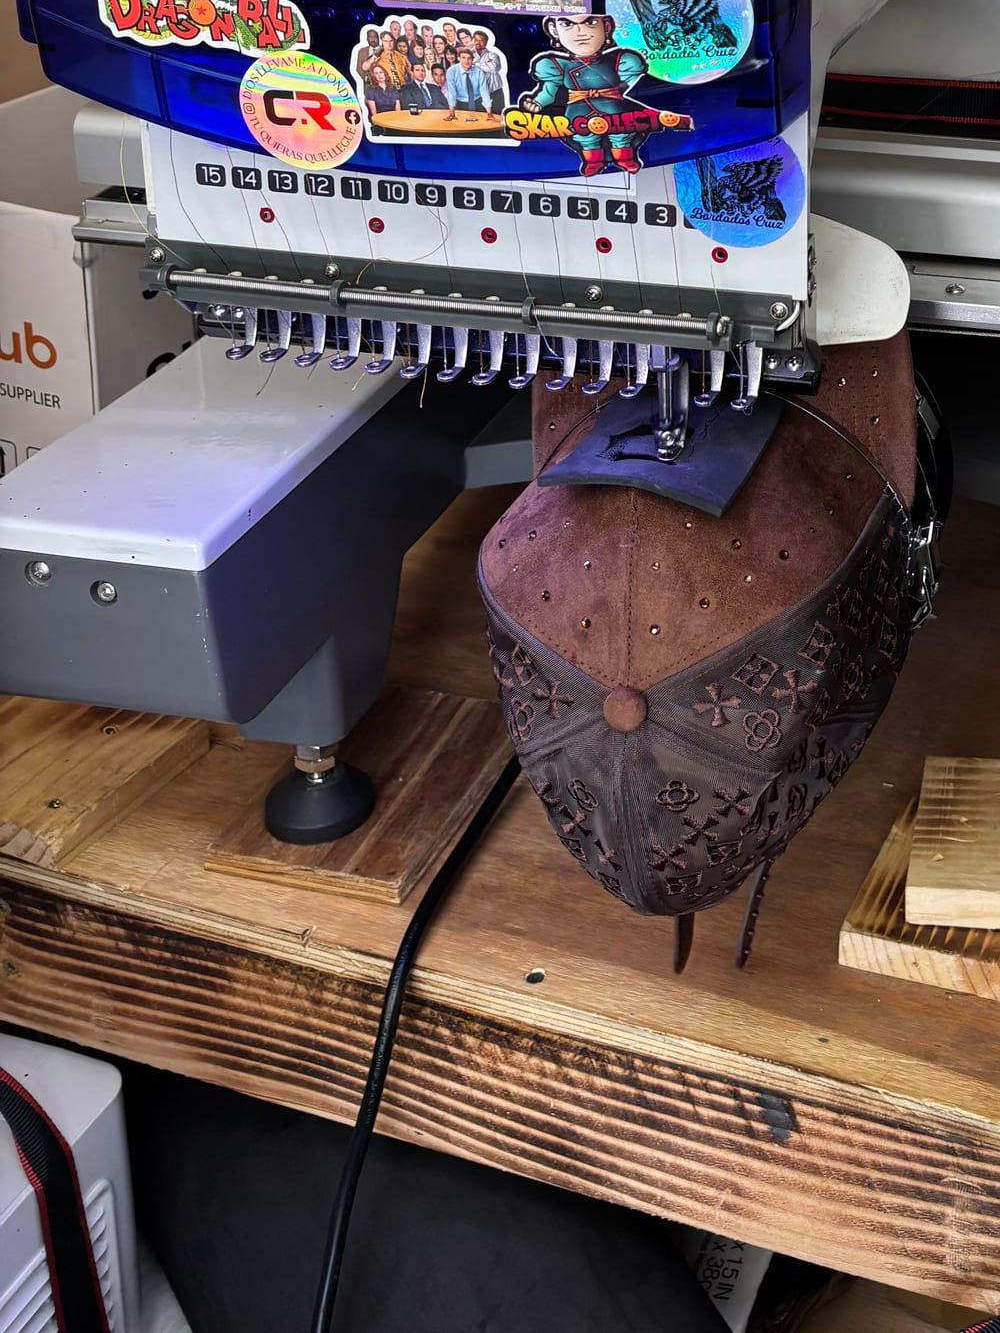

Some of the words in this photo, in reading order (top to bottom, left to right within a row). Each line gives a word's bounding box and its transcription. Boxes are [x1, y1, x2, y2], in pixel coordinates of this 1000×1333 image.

[702, 44, 738, 57] Cruz
[504, 110, 574, 140] SKAR
[260, 131, 303, 161] QUIERAS
[305, 152, 329, 164] QUE
[201, 166, 221, 184] 15
[237, 169, 257, 187] 14
[273, 173, 293, 190] 13
[309, 176, 330, 194] 12
[349, 179, 363, 198] 11
[384, 182, 404, 201] 10
[426, 186, 439, 204] 9
[463, 190, 476, 207] 8
[500, 193, 513, 210] 7
[539, 196, 553, 214] 6
[577, 200, 590, 217] 5
[614, 203, 628, 220] 4
[655, 207, 669, 224] 3
[690, 208, 751, 226] Bordados
[753, 215, 785, 230] Cruz
[0, 382, 61, 409] SUPPLIER
